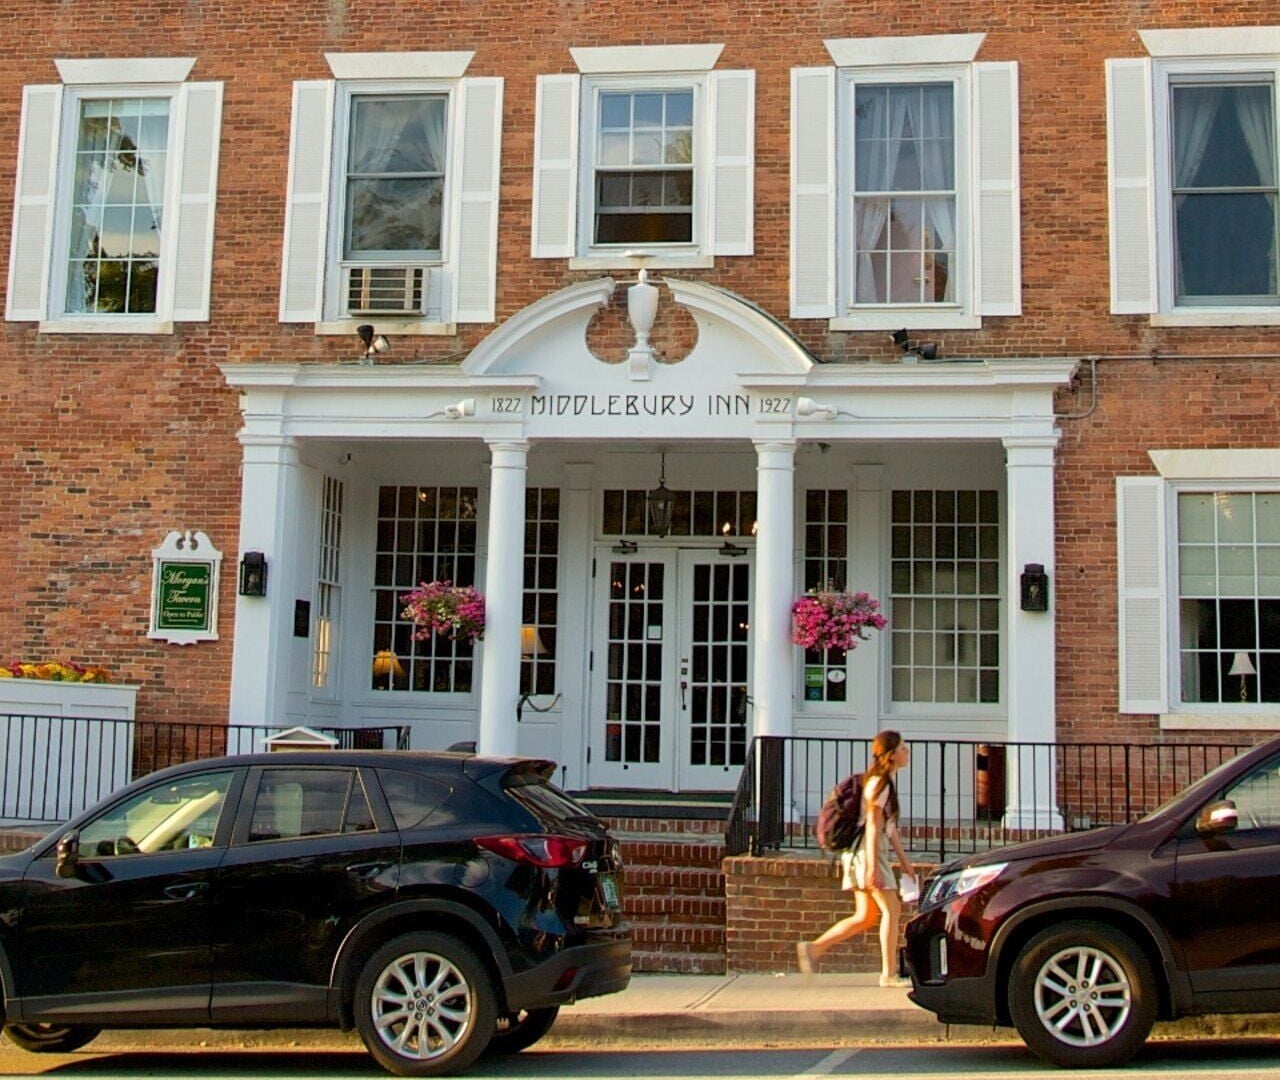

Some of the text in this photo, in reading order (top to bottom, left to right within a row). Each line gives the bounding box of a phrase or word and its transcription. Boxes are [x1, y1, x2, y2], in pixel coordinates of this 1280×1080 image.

[491, 395, 791, 416] 1827 MIDDLEBURY INN 1927
[162, 569, 209, 589] Morgan's
[166, 589, 201, 603] Tavern
[163, 611, 179, 619] Open
